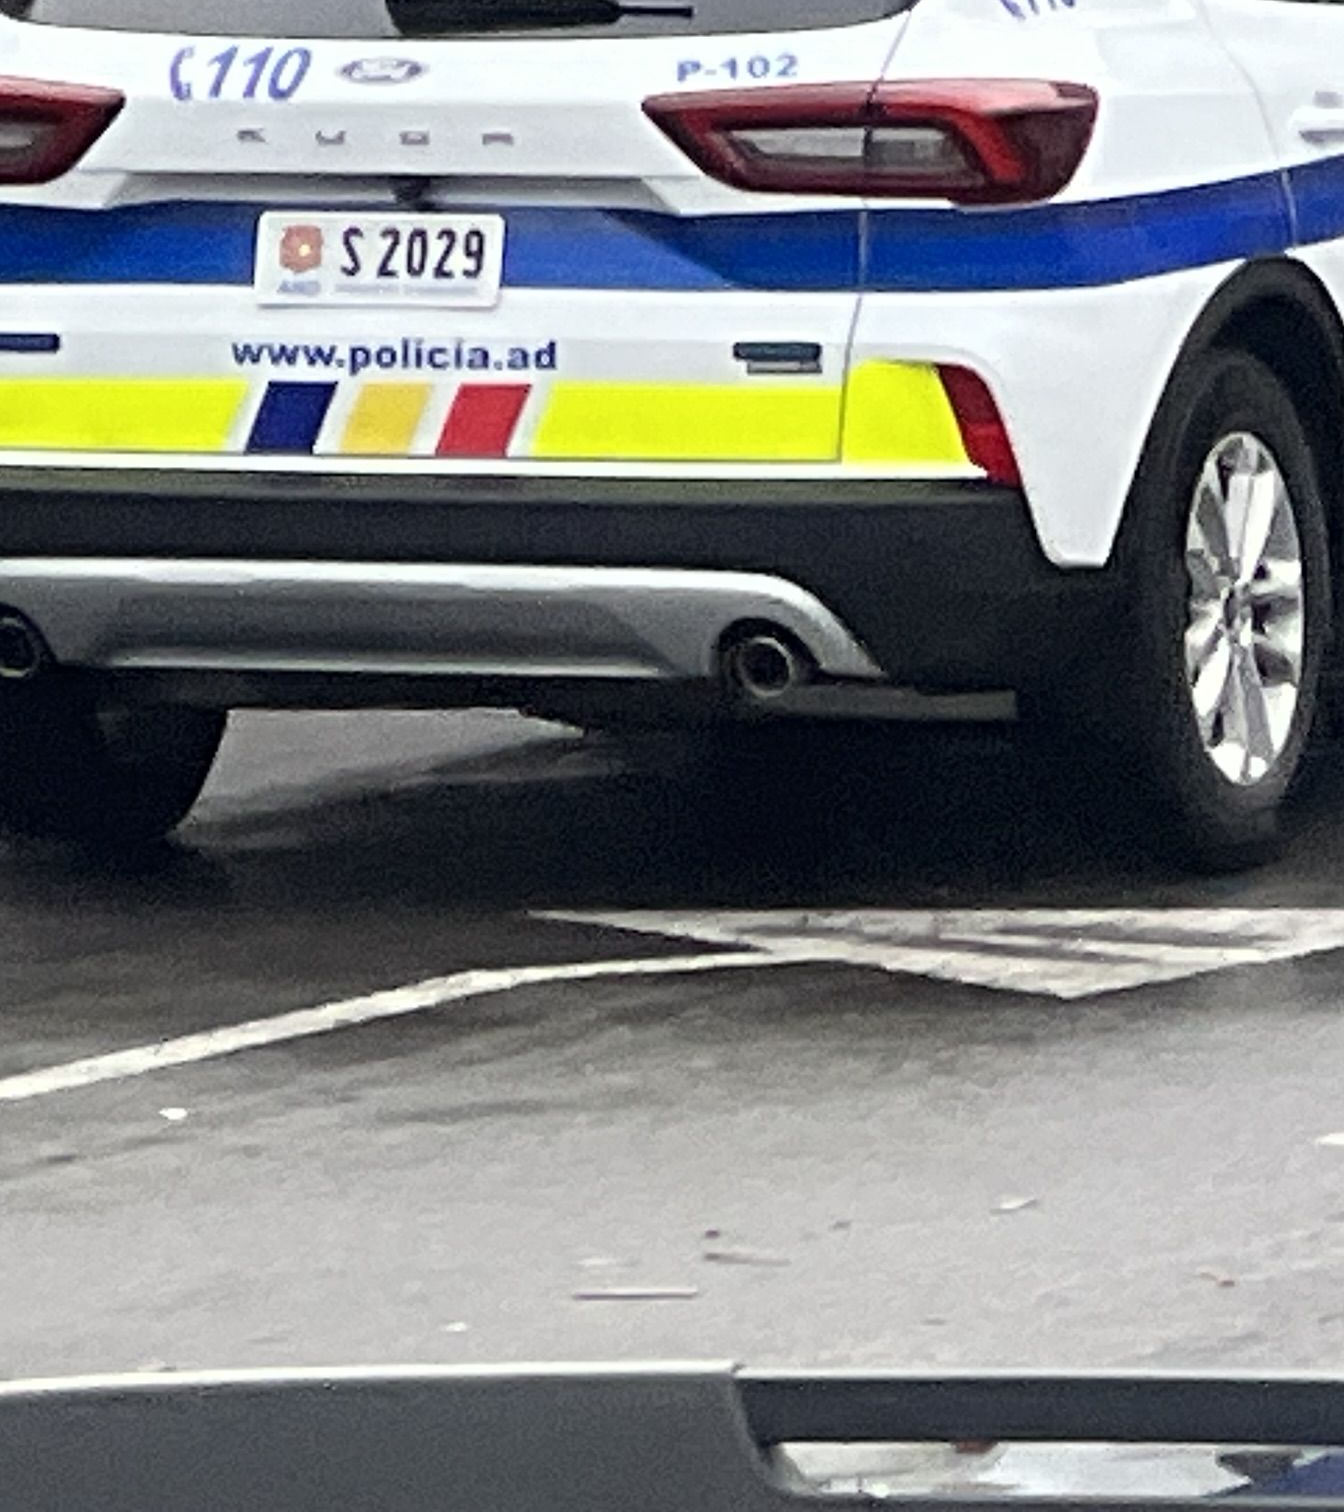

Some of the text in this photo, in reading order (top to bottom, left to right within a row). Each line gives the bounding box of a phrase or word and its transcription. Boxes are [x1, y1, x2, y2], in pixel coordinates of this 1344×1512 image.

[208, 45, 313, 101] 110
[676, 53, 799, 82] P-102
[340, 226, 486, 279] S 2029
[231, 337, 558, 376] www.policia.ad
